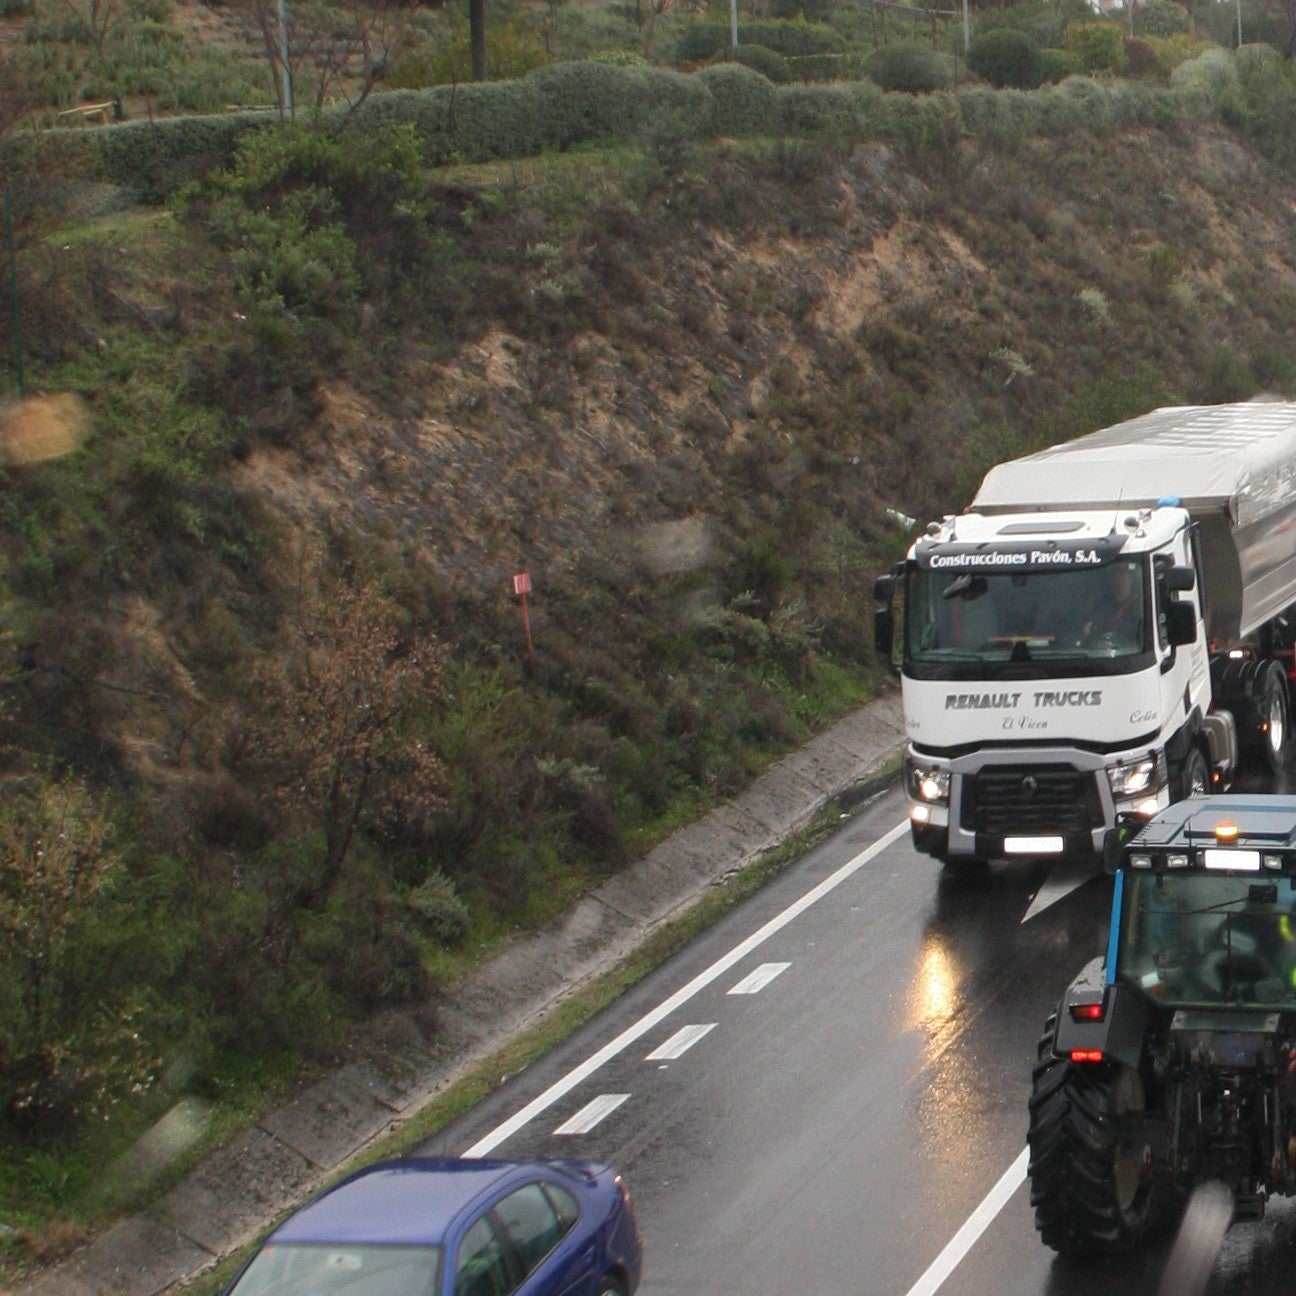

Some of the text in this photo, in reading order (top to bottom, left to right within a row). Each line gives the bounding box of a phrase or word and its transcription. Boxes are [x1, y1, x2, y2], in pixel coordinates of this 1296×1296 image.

[929, 549, 1102, 568] Construcciones Pavón, S.A.
[944, 690, 1103, 710] RENAULT TRUCKS
